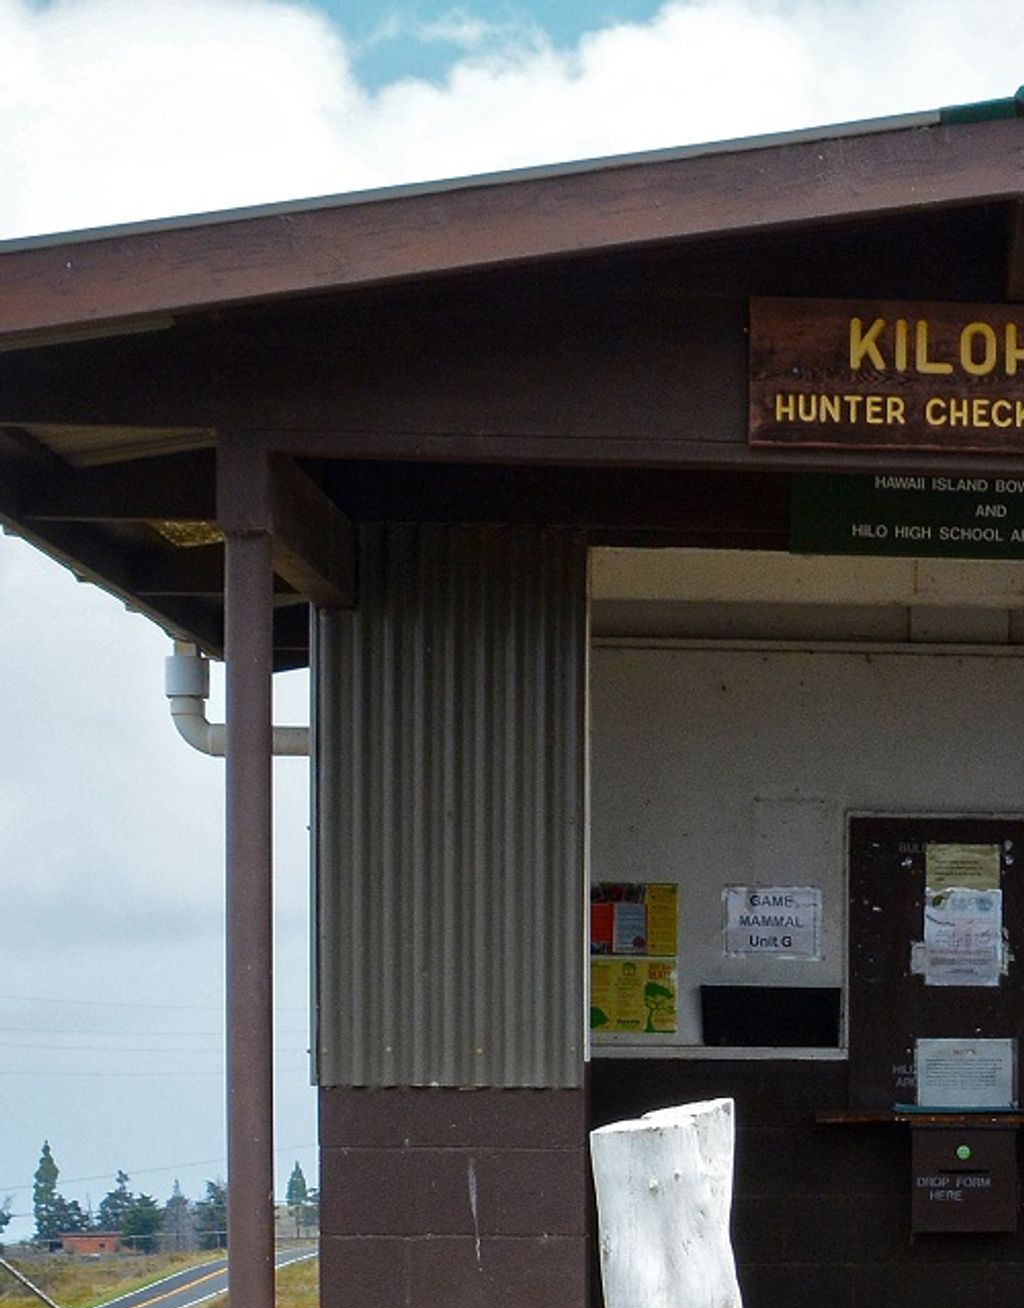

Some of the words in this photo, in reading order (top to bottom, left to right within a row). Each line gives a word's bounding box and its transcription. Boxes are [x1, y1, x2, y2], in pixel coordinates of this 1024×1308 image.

[775, 393, 905, 424] HUNTER
[874, 475, 925, 490] HAWAII
[932, 477, 988, 493] ISLAND
[975, 503, 1007, 518] AND
[851, 523, 888, 539] HILO
[895, 525, 931, 540] HIGH
[940, 527, 1003, 543] SCHOOL
[749, 894, 793, 908] GAME
[739, 914, 804, 928] MAMMAL
[749, 934, 778, 948] Unit
[780, 935, 792, 948] G
[916, 1176, 950, 1188] DROP
[955, 1176, 992, 1188] FORM
[929, 1190, 963, 1201] HERE
